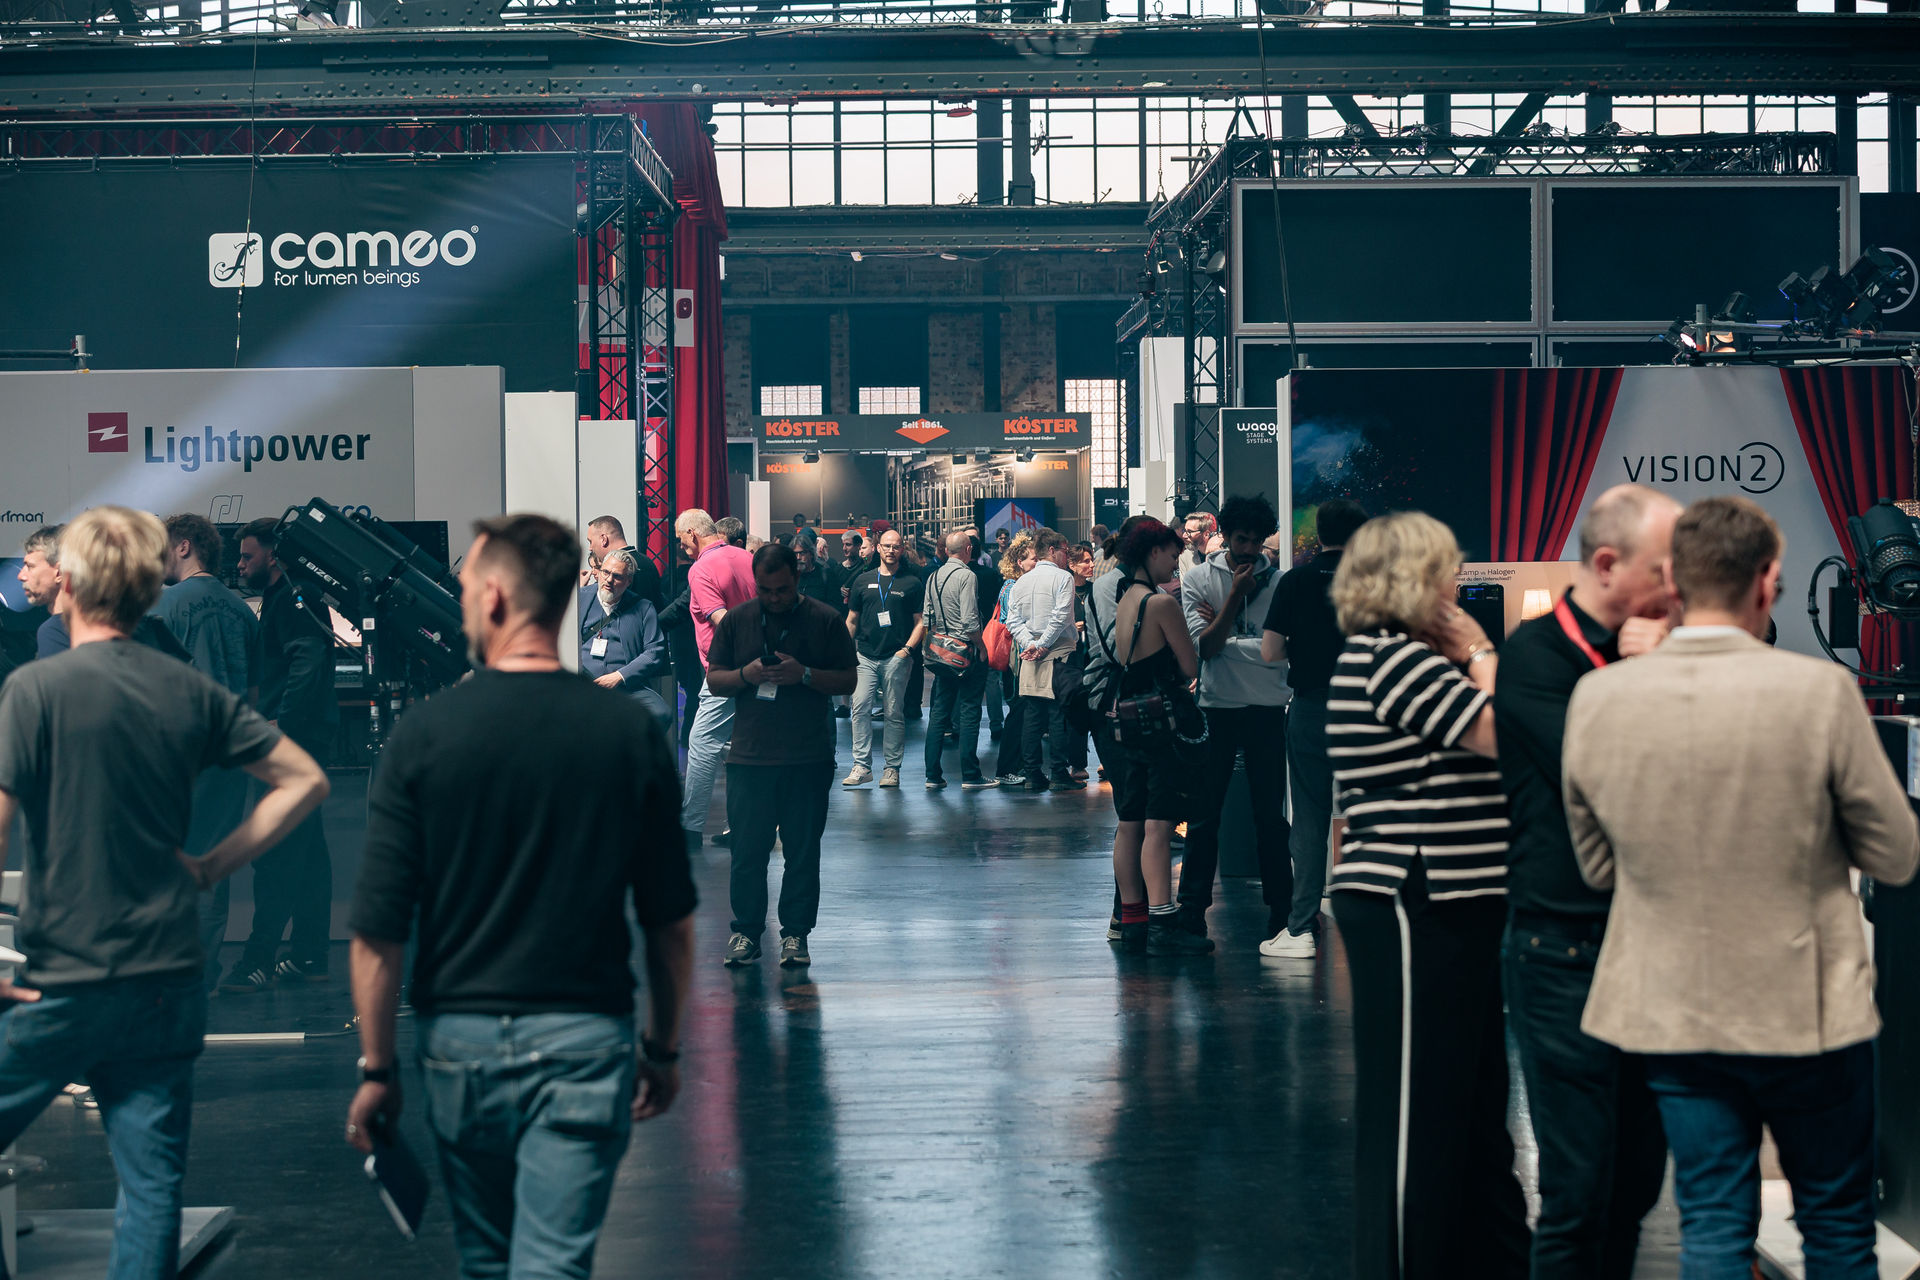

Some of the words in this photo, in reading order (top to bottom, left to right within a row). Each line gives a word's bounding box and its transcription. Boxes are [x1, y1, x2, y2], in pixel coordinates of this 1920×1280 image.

[274, 272, 298, 286] for
[304, 271, 357, 286] lumen
[363, 269, 420, 288] beings
[765, 419, 840, 437] KÖSTER
[902, 421, 919, 429] Seit
[1004, 416, 1079, 434] KÖSTER
[145, 426, 371, 473] Lightpower
[306, 561, 340, 586] BIZET
[1487, 568, 1516, 576] Halogen
